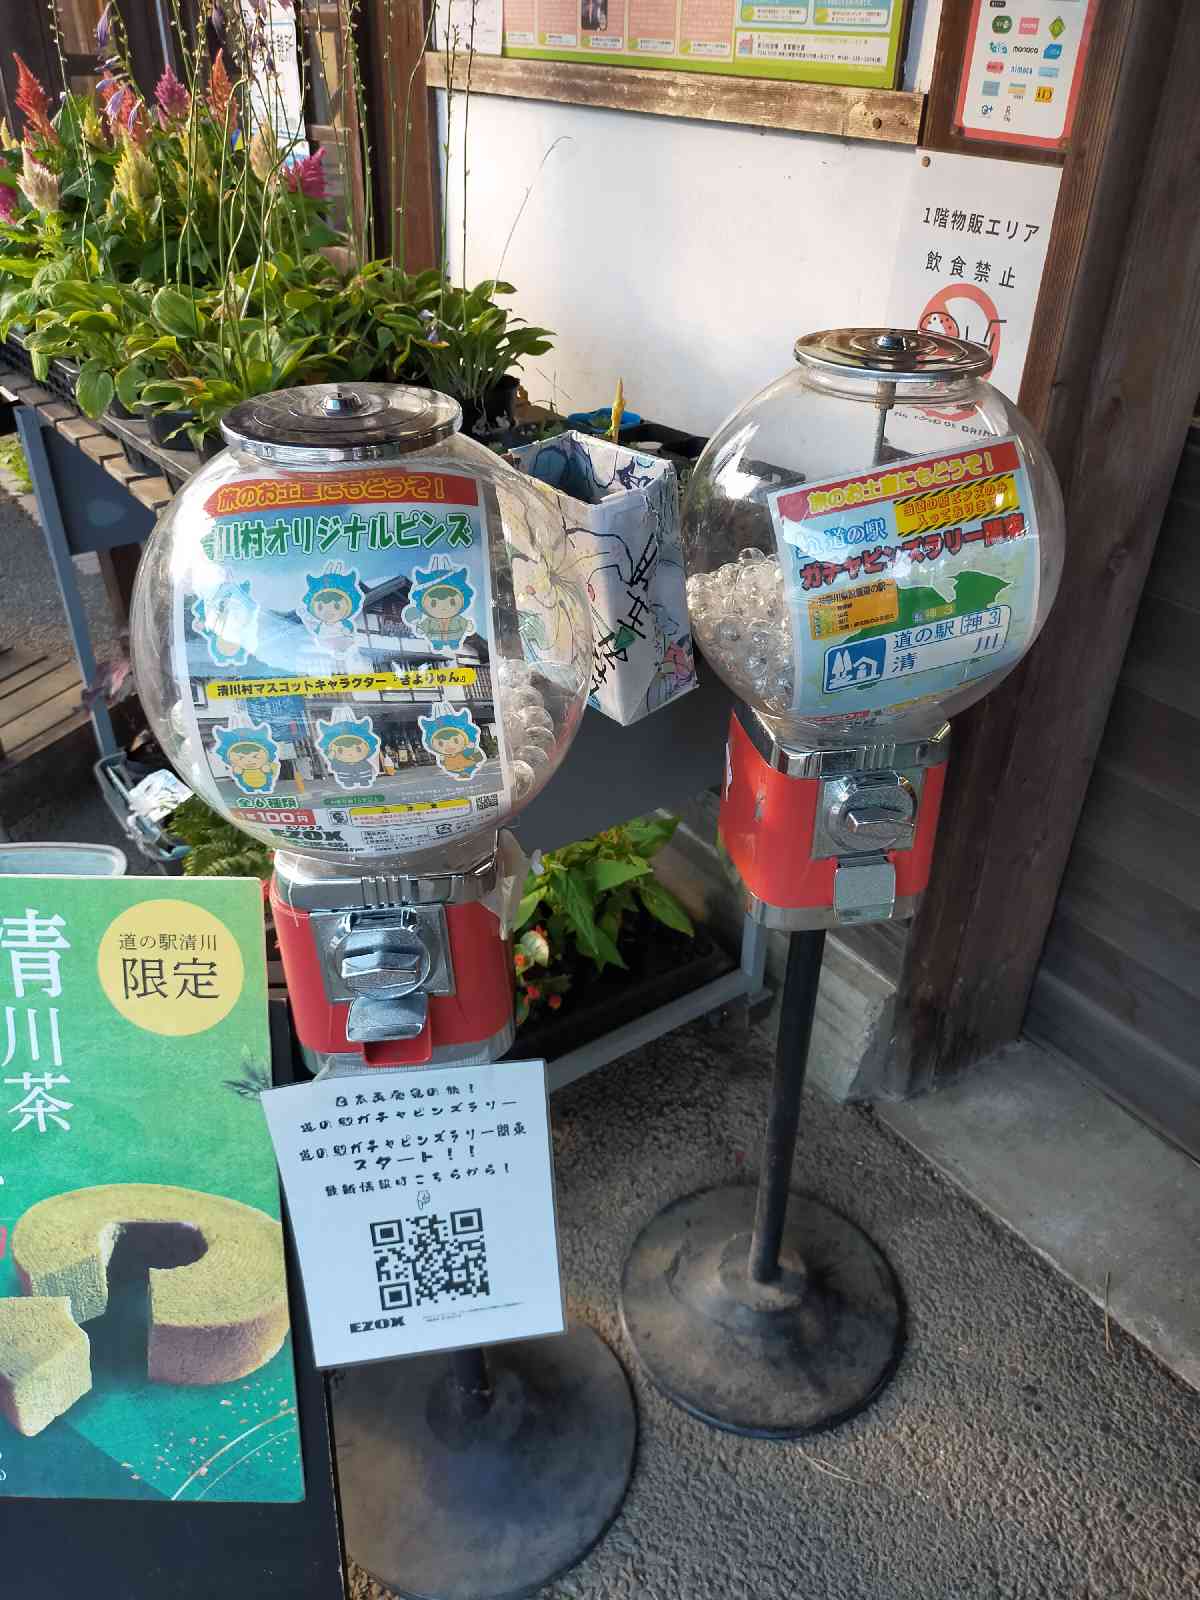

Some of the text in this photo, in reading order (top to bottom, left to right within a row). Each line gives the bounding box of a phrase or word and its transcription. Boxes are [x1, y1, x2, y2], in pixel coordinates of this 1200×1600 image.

[922, 207, 1040, 243] 1階物販エリア
[925, 250, 1016, 289] 飲食禁止
[894, 621, 954, 648] 道の駅
[119, 932, 217, 951] 道の駅清川
[121, 957, 220, 1000] 限定
[350, 1315, 406, 1333] EZOX
